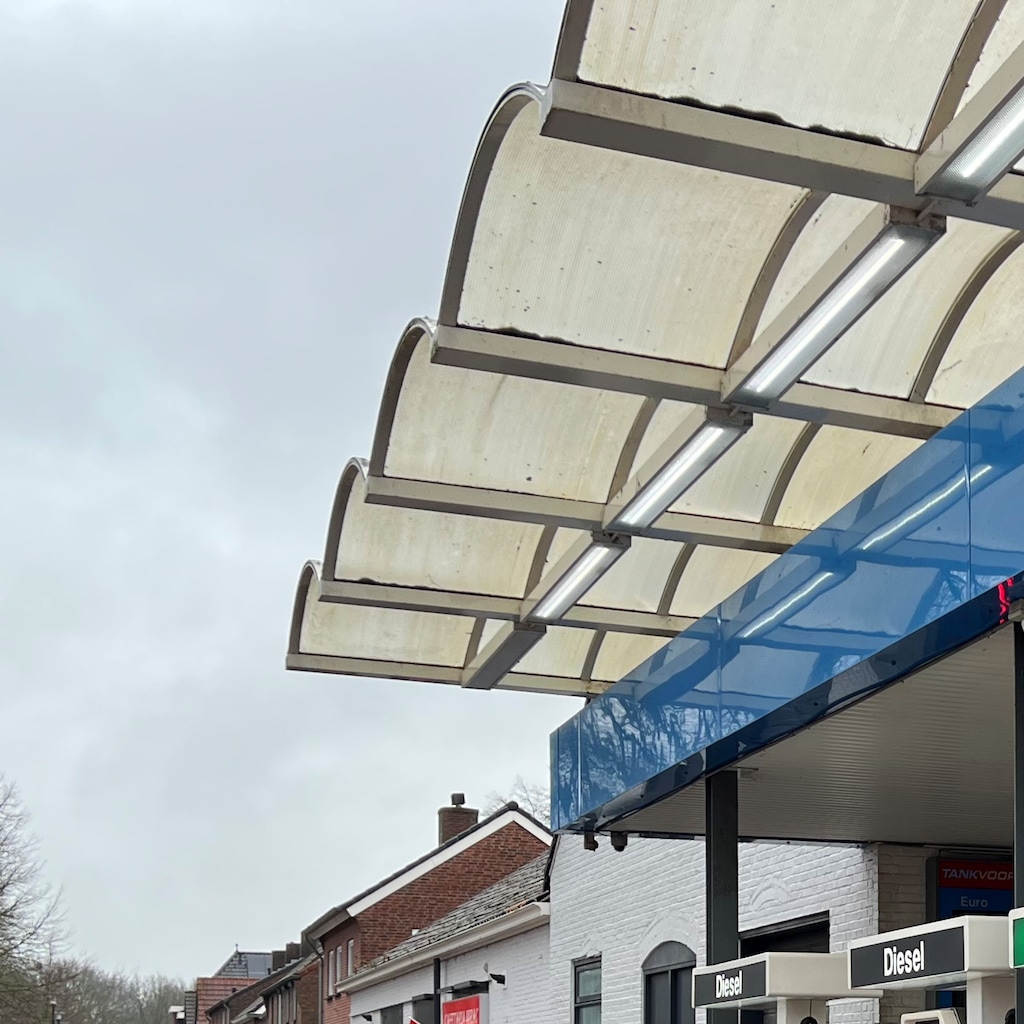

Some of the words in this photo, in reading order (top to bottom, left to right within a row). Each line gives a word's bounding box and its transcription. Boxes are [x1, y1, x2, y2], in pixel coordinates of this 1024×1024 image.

[960, 896, 989, 908] Euro
[883, 940, 925, 977] Diesel
[715, 970, 743, 999] Diesel
